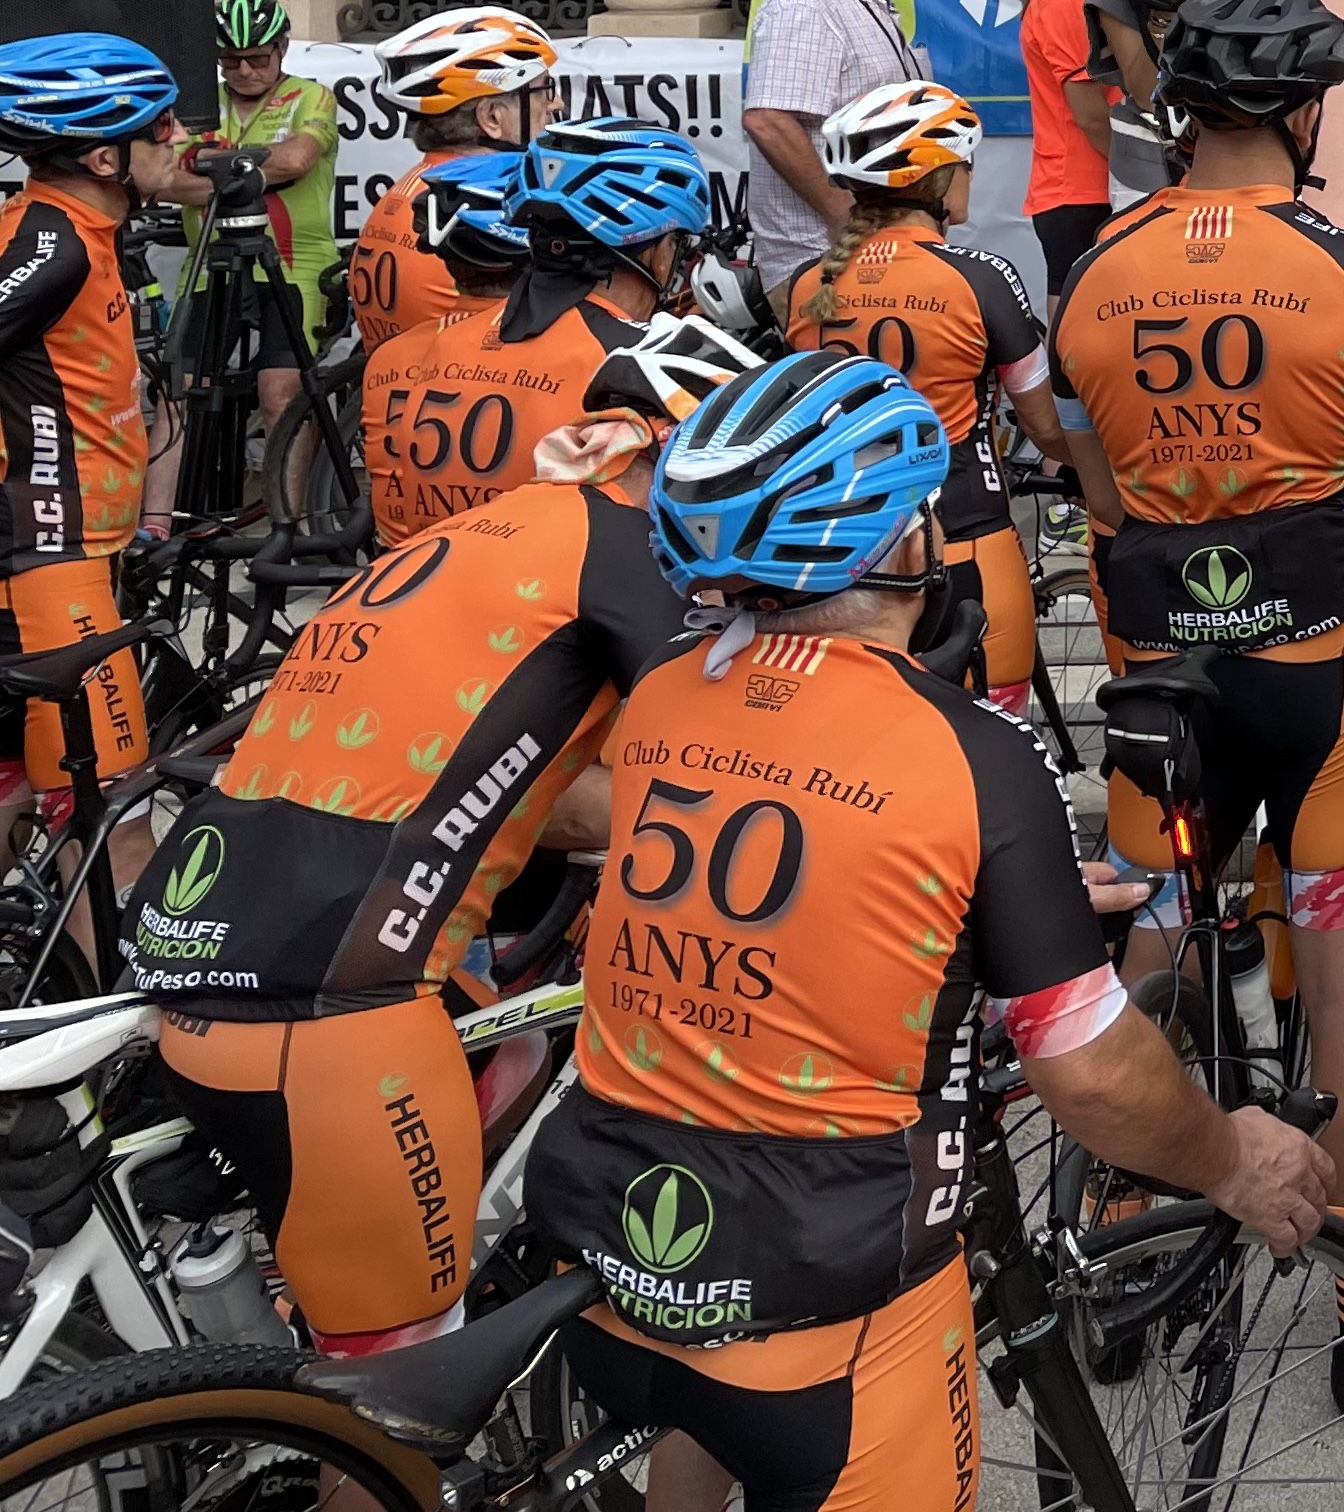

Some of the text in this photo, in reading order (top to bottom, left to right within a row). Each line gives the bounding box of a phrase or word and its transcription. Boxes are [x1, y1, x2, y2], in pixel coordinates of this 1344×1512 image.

[903, 294, 949, 315] Rubí
[1096, 288, 1312, 323] Club Ciclista Rubí
[511, 368, 565, 396] Rubí
[1132, 313, 1265, 395] 50
[409, 389, 514, 474] 50
[1147, 401, 1263, 441] ANYS
[1151, 443, 1255, 465] 1971-2021
[467, 518, 528, 540] Rubí
[1167, 598, 1291, 629] HERBALIFE
[622, 740, 894, 816] Club Ciclista Rubí
[377, 732, 543, 953] C.C. RUBI
[619, 777, 805, 924] 50
[139, 901, 231, 941] HERBALIFE
[607, 917, 777, 1001] ANYS
[609, 981, 755, 1039] 1971-2021
[384, 1092, 458, 1295] HERBALIFE
[581, 1247, 753, 1306] HERBALIFE
